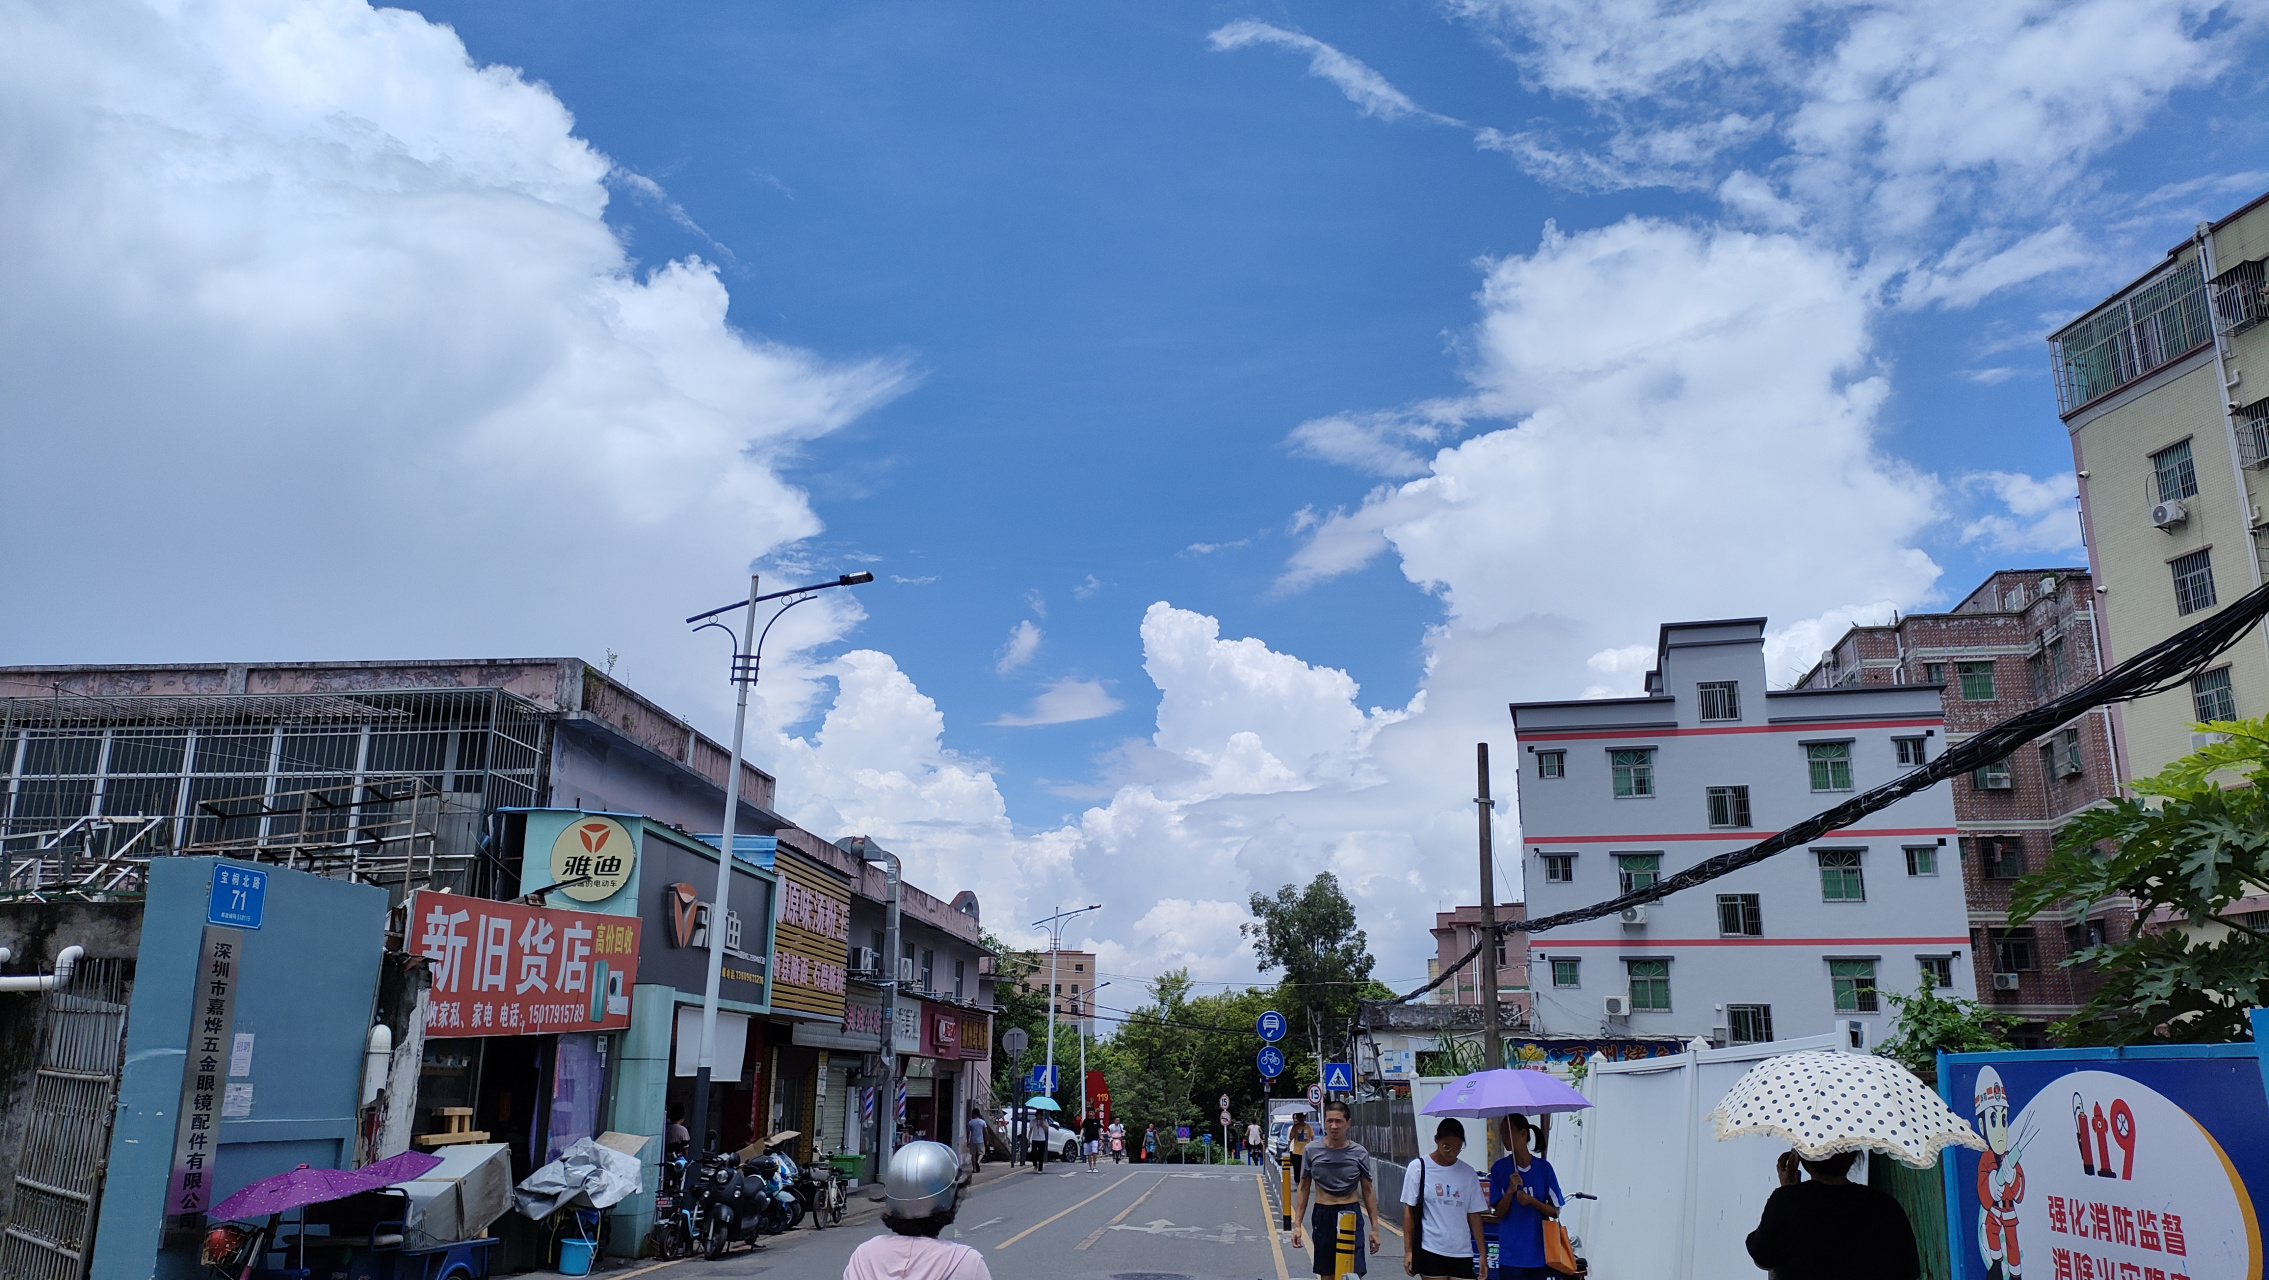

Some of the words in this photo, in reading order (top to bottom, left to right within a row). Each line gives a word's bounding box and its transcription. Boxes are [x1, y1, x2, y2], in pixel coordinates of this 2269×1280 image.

[561, 855, 622, 876] 雅迪
[220, 870, 261, 889] 宝桐北路
[231, 889, 246, 911] 71
[595, 923, 634, 954] 高价回收
[422, 905, 592, 996] 新旧货店
[529, 1004, 585, 1024] 15017915789
[178, 942, 233, 1231] 深圳市嘉烨五金眼镜配件有限公司
[1311, 1089, 1320, 1100] 15
[1096, 1093, 1109, 1102] 119
[1221, 1098, 1228, 1107] 15
[2047, 1195, 2187, 1257] 强化消防监督
